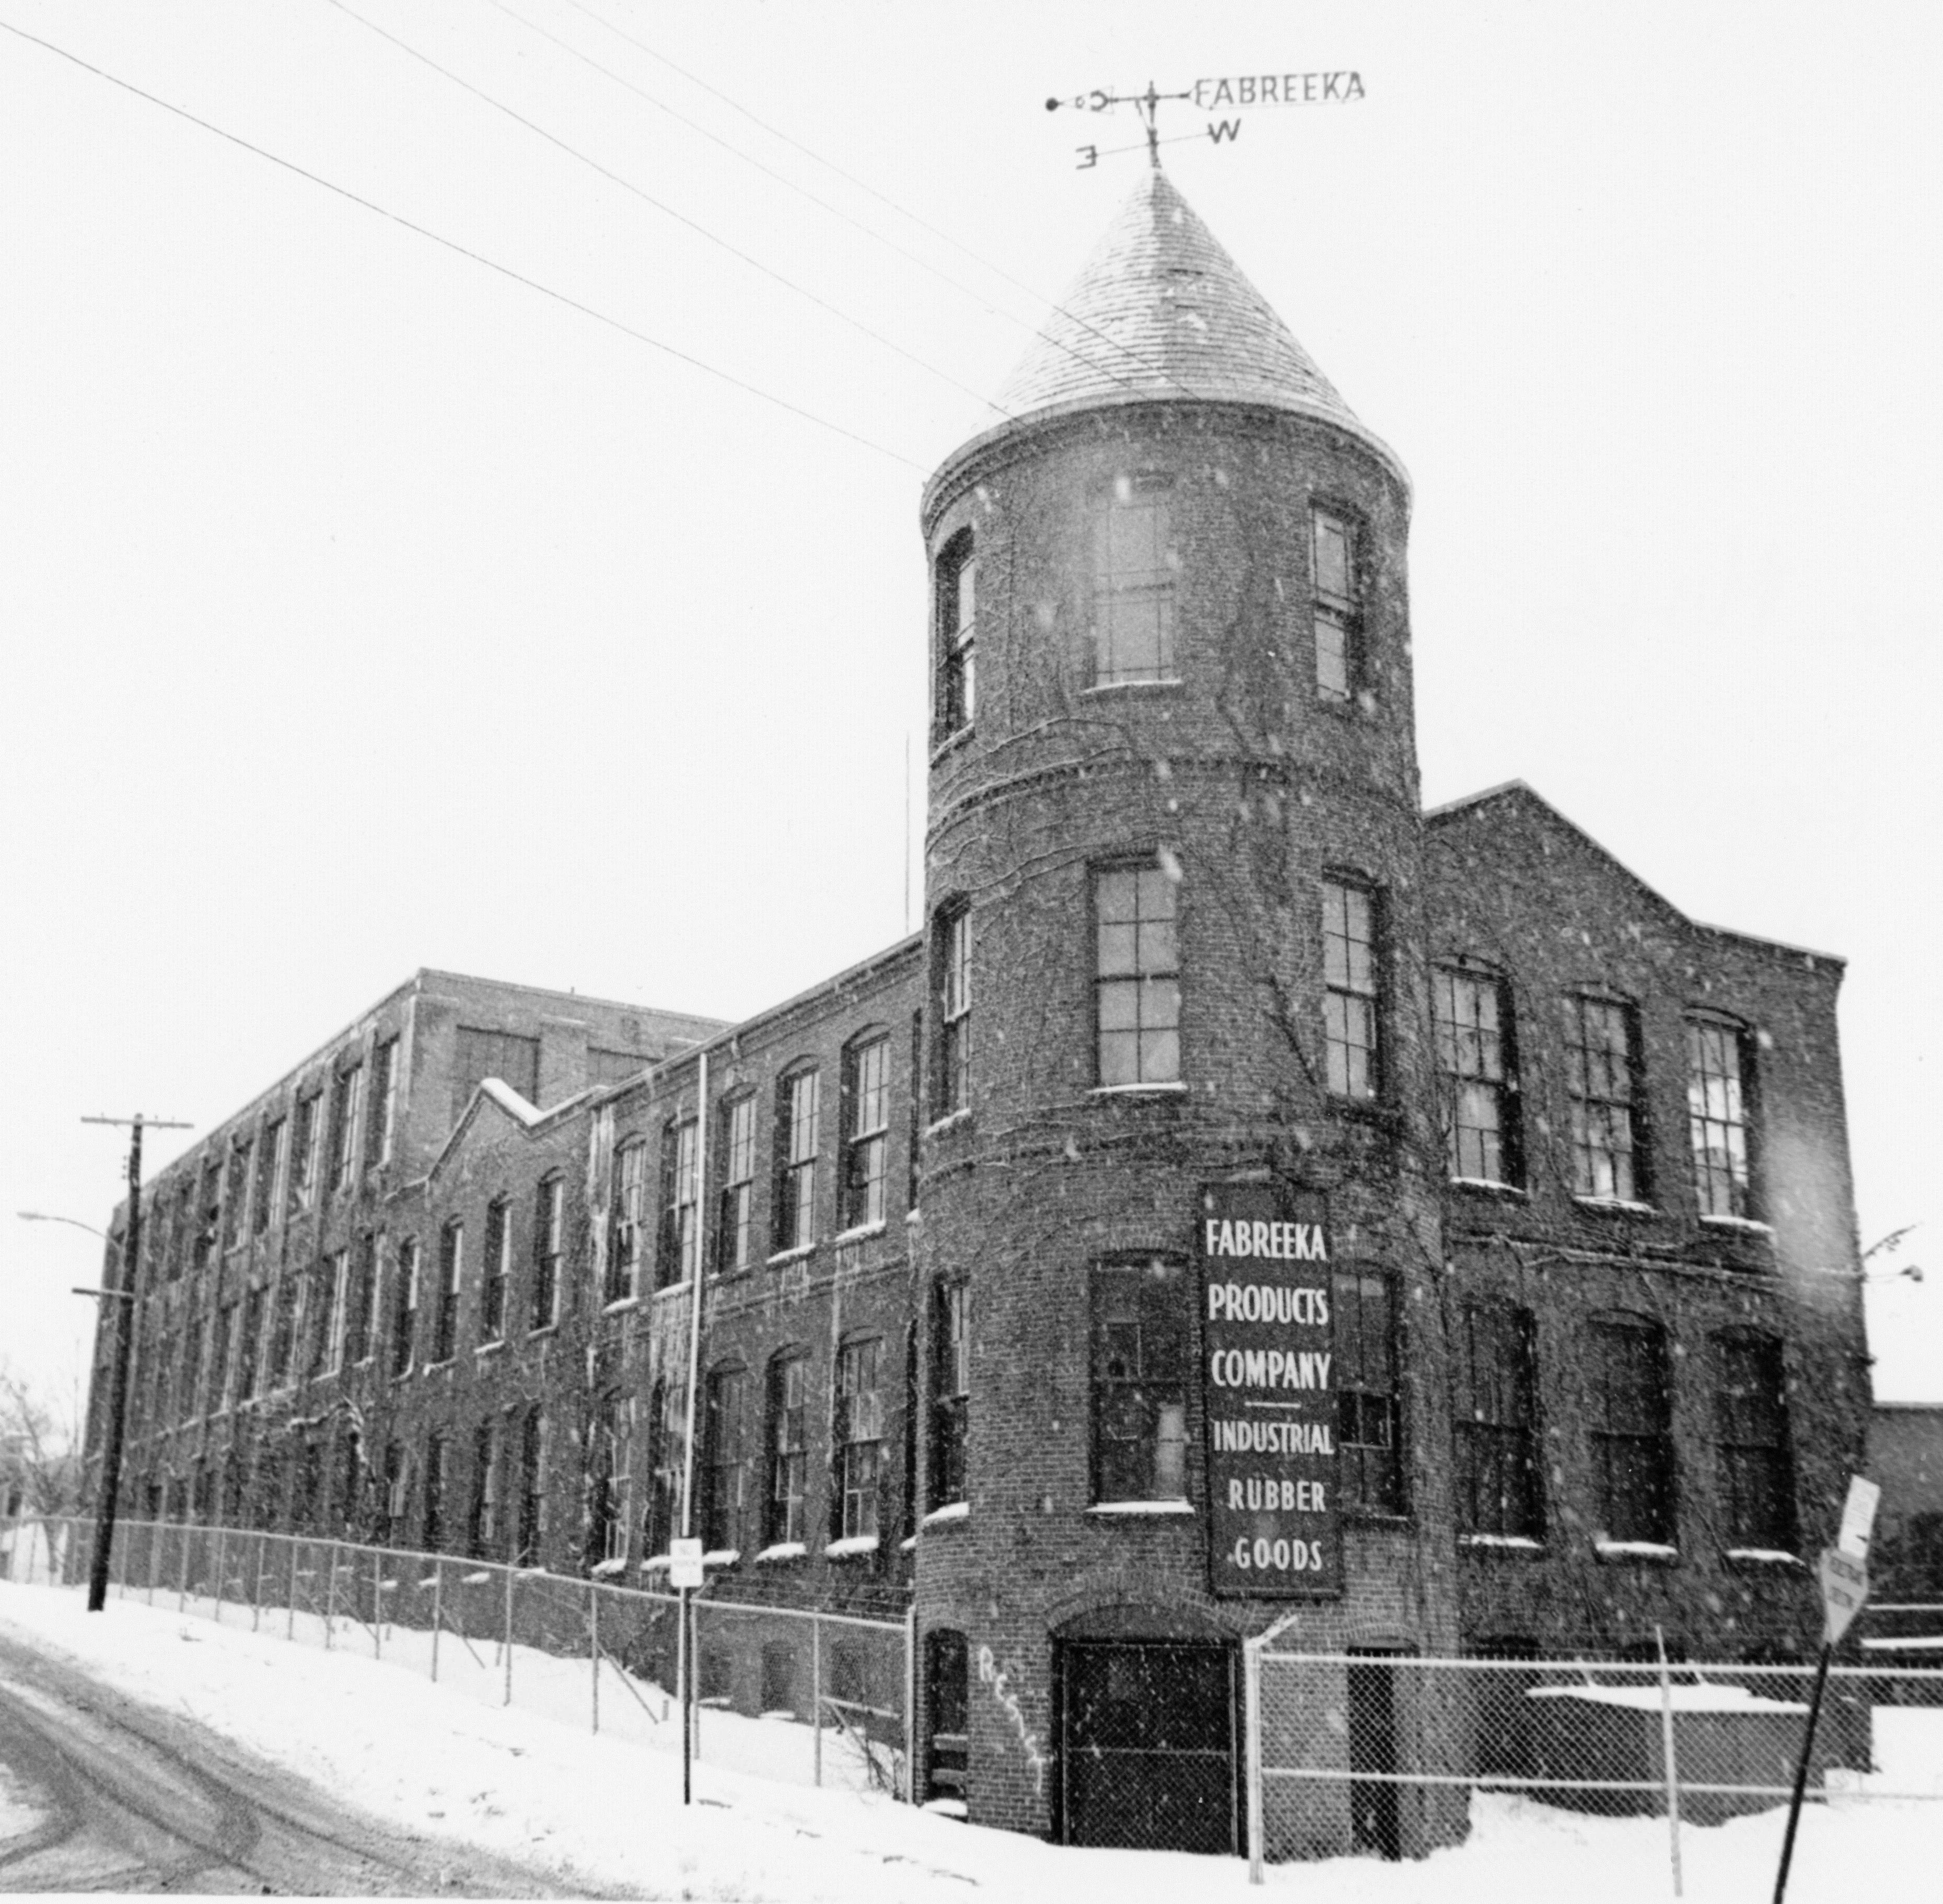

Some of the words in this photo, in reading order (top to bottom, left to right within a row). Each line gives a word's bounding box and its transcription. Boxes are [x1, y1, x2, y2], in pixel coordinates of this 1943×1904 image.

[1195, 71, 1366, 108] FABREEKA
[1207, 118, 1241, 144] W
[1205, 1218, 1328, 1261] FABREEKA
[1208, 1283, 1329, 1326] PRODUCTS
[1211, 1349, 1332, 1390] COMPANY
[1214, 1420, 1335, 1455] INDUSTRIAL
[1228, 1479, 1327, 1512] RUBBER
[1234, 1537, 1323, 1571] GOODS
